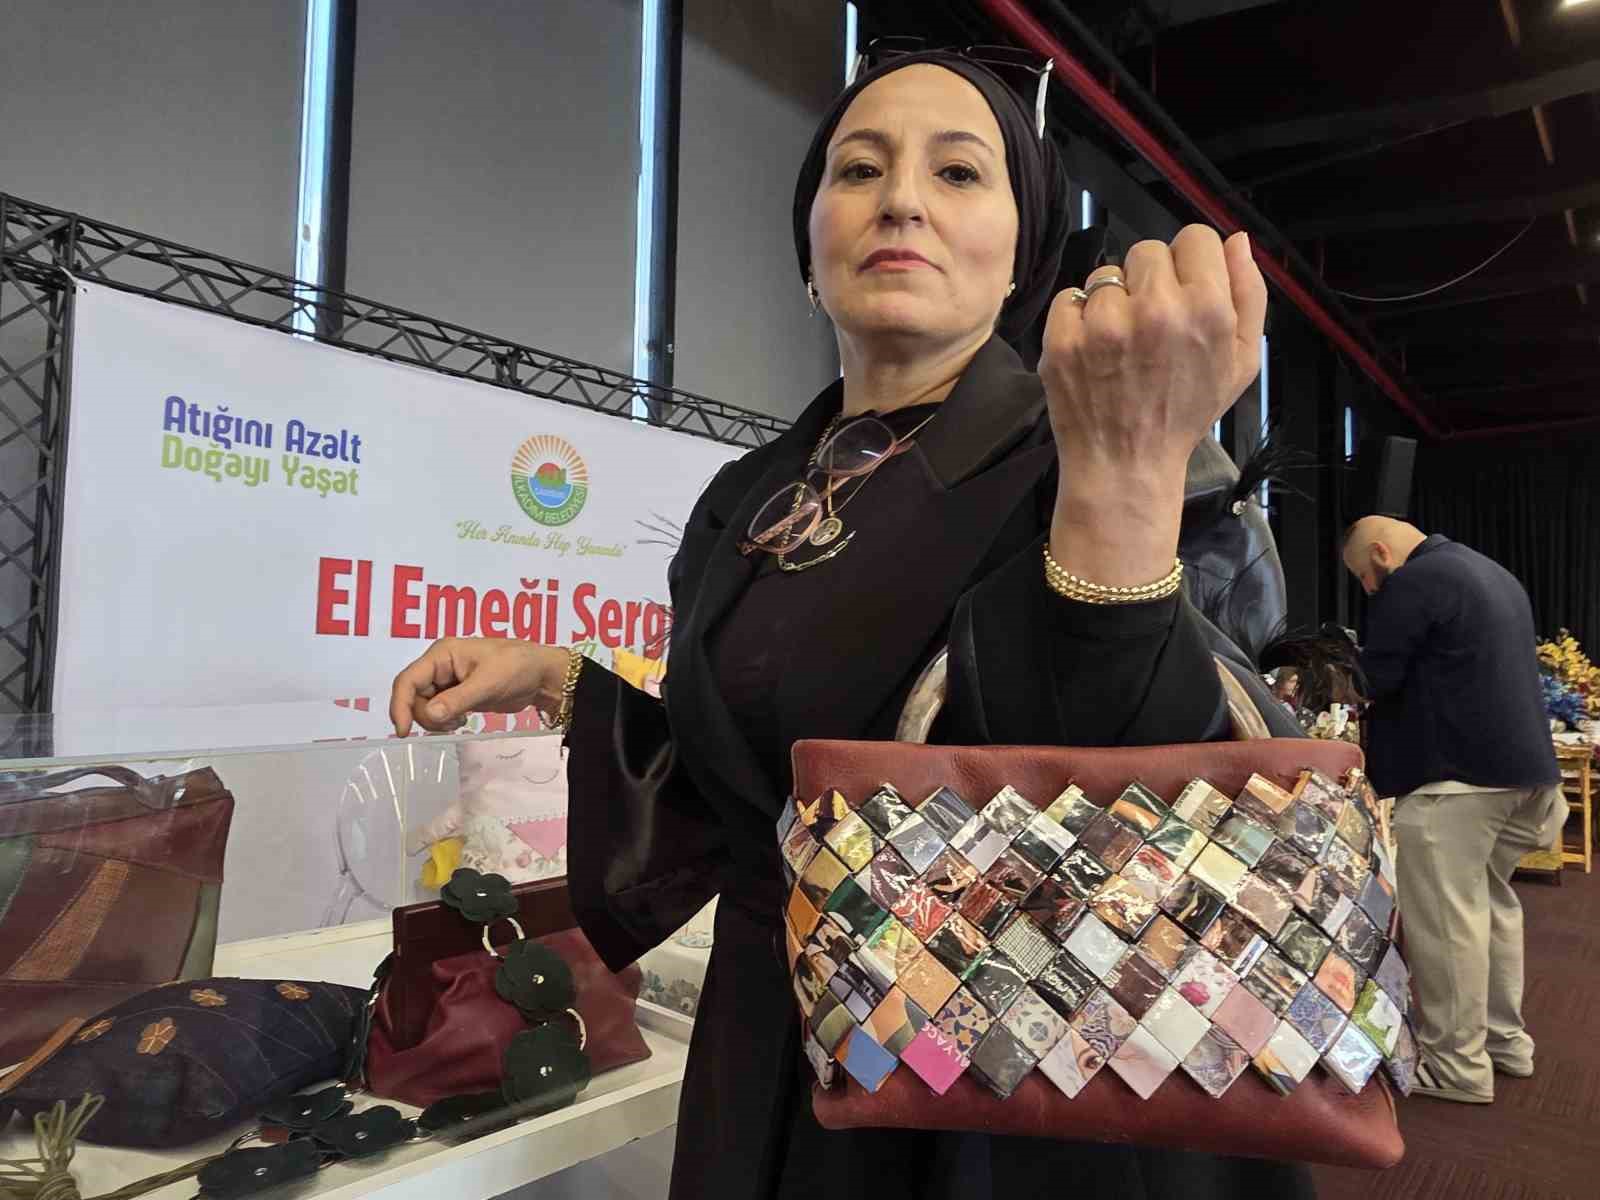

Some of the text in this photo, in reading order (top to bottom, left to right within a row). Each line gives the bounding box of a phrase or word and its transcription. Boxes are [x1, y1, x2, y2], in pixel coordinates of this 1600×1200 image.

[163, 395, 362, 464] Atığını Azalt
[161, 433, 359, 498] Doğayı Yaşat
[315, 556, 373, 637] El
[390, 563, 560, 645] Emeği
